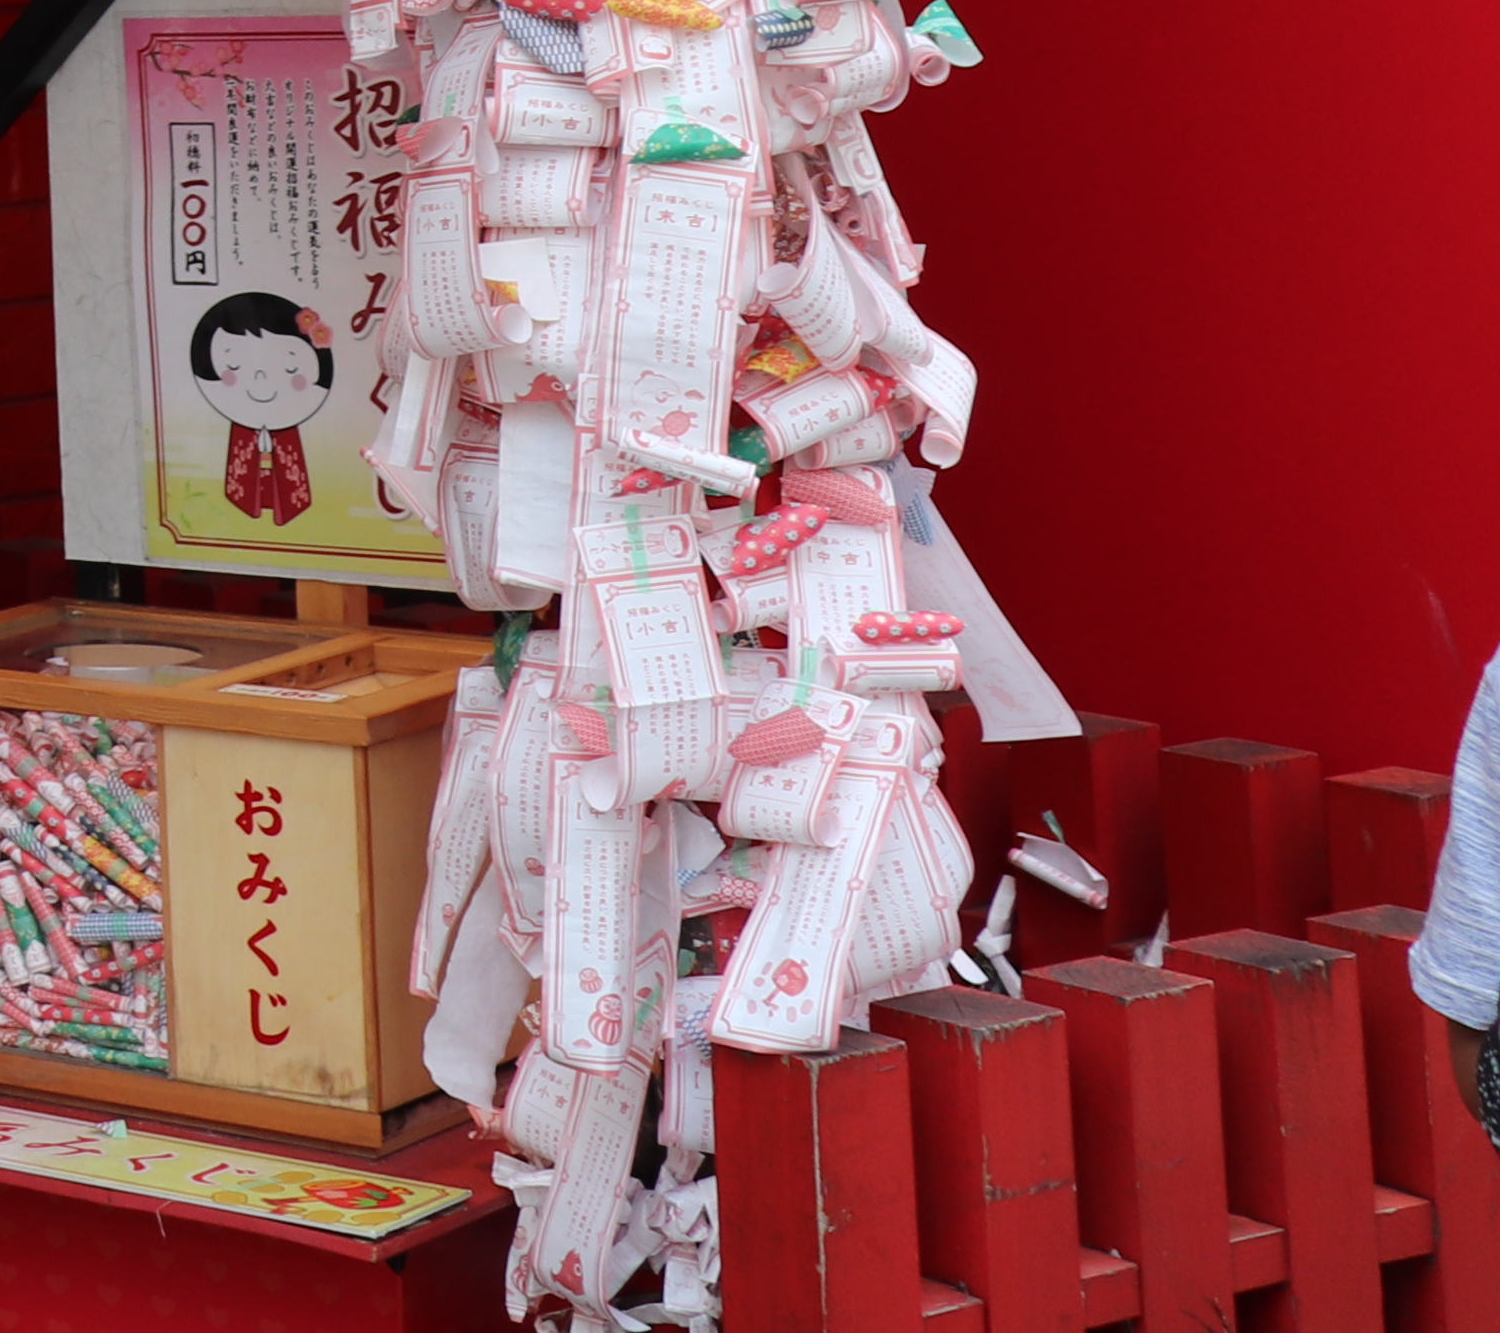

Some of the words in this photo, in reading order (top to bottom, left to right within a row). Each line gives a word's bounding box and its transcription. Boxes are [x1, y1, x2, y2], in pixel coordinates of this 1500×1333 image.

[527, 98, 590, 113] 招福みくじ
[651, 193, 714, 210] 招福みくじ
[233, 778, 292, 1047] おみくじ
